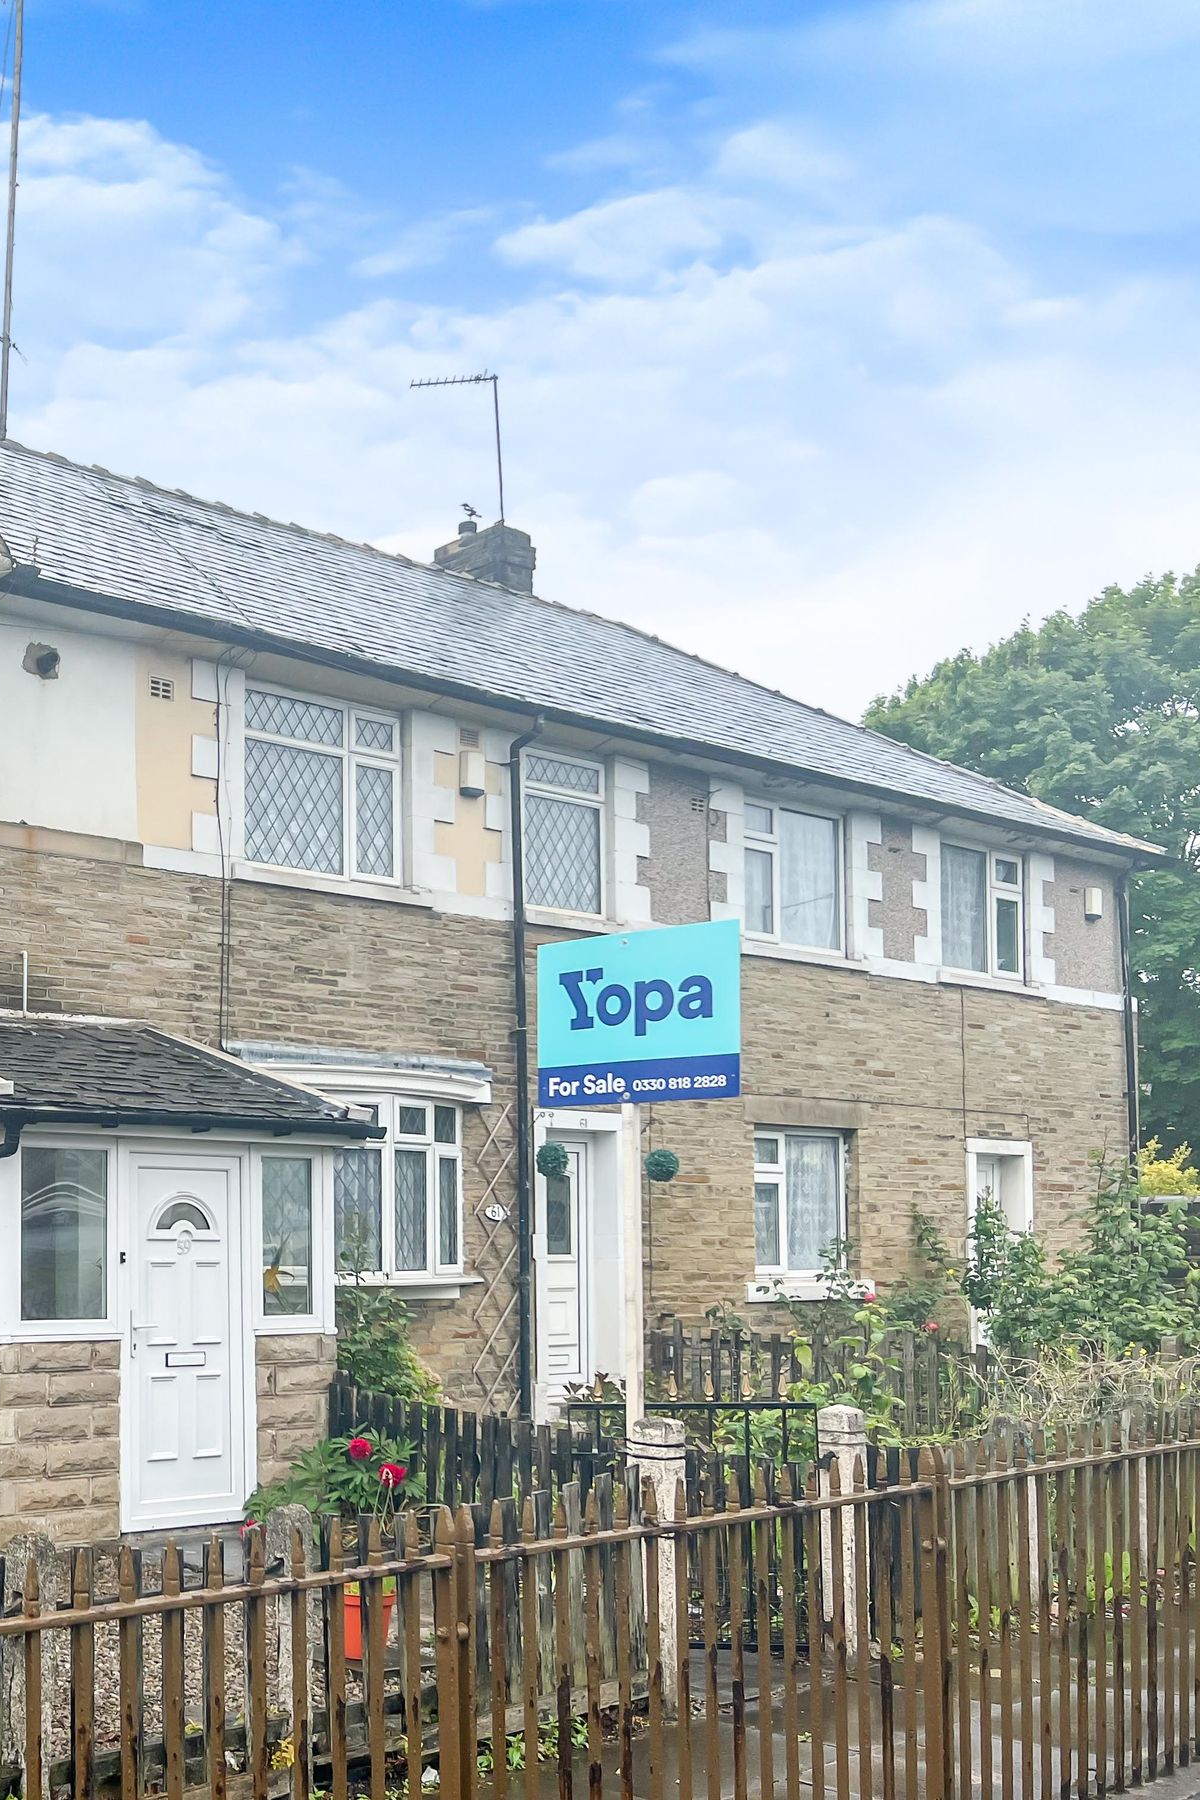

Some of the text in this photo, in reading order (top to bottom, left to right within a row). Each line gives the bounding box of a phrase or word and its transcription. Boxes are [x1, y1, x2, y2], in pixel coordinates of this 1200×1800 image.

[558, 967, 714, 1037] Yopa
[548, 1073, 728, 1098] For Sale 0330 818 2828
[579, 1118, 588, 1128] 61
[490, 1206, 501, 1218] 61
[176, 1238, 192, 1256] 59
